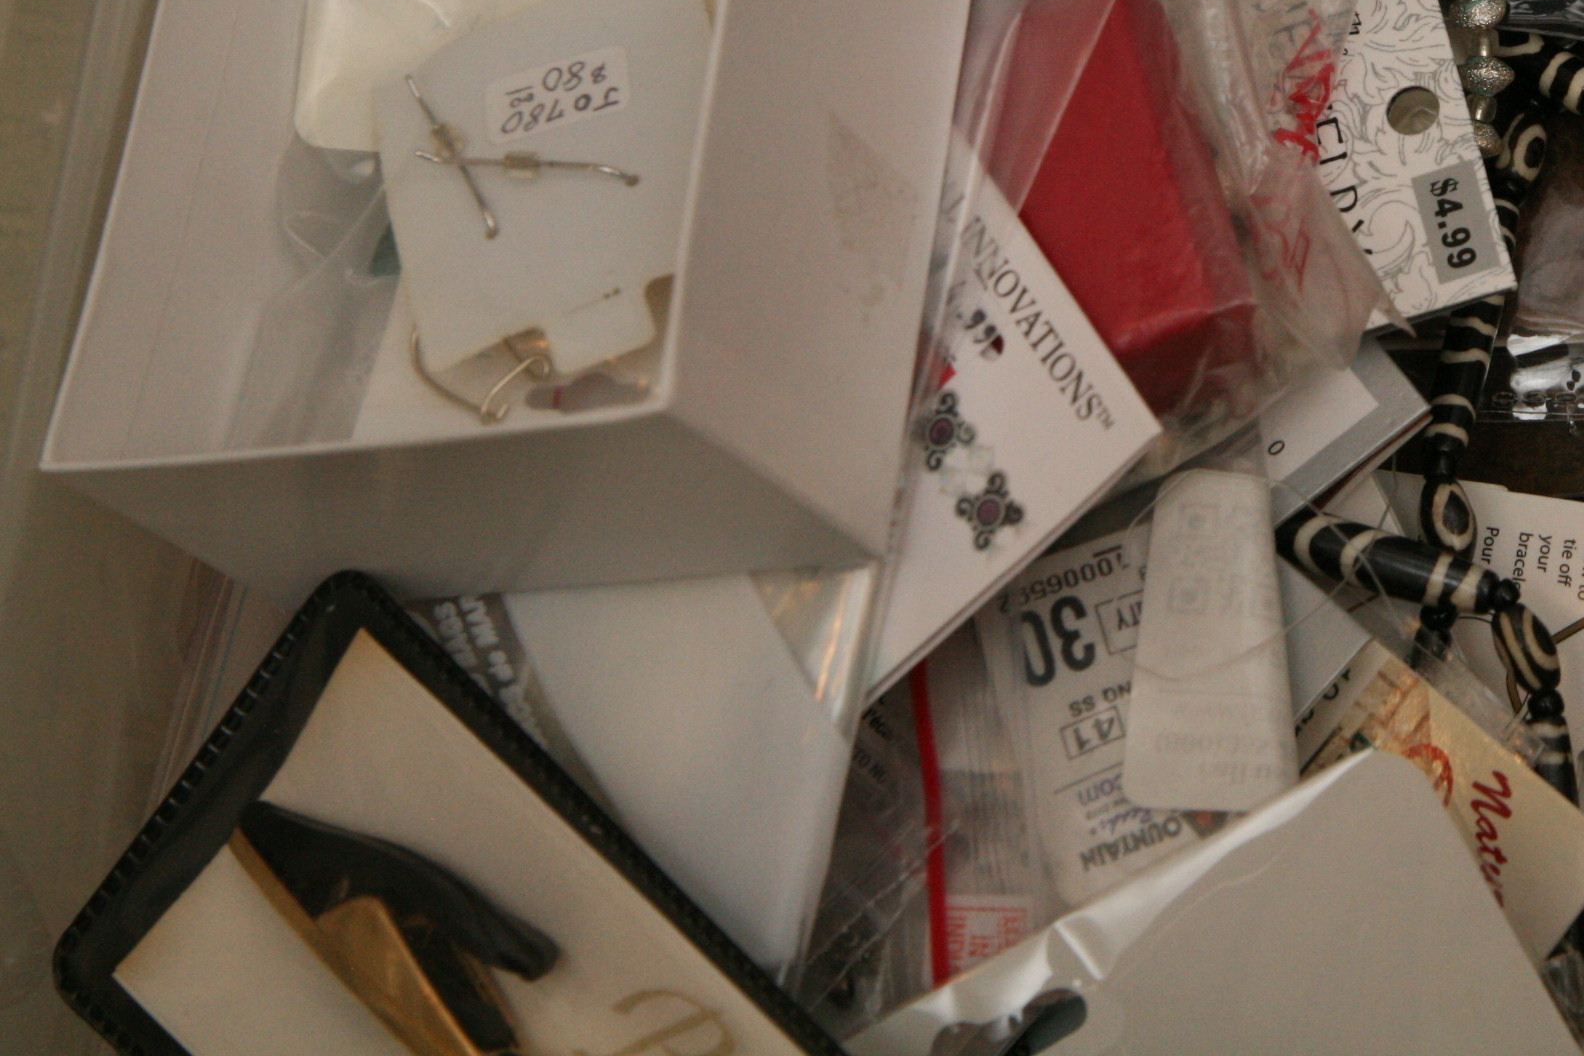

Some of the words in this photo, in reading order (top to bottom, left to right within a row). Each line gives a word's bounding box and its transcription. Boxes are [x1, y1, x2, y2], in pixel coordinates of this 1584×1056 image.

[1429, 177, 1477, 268] $4.99
[1480, 525, 1499, 565] Pour
[1511, 531, 1532, 584] bracel
[1534, 534, 1552, 572] your
[1561, 538, 1577, 559] tie
[1556, 562, 1573, 587] off
[1022, 600, 1093, 687] 30
[1079, 815, 1181, 871] OUNTAIN
